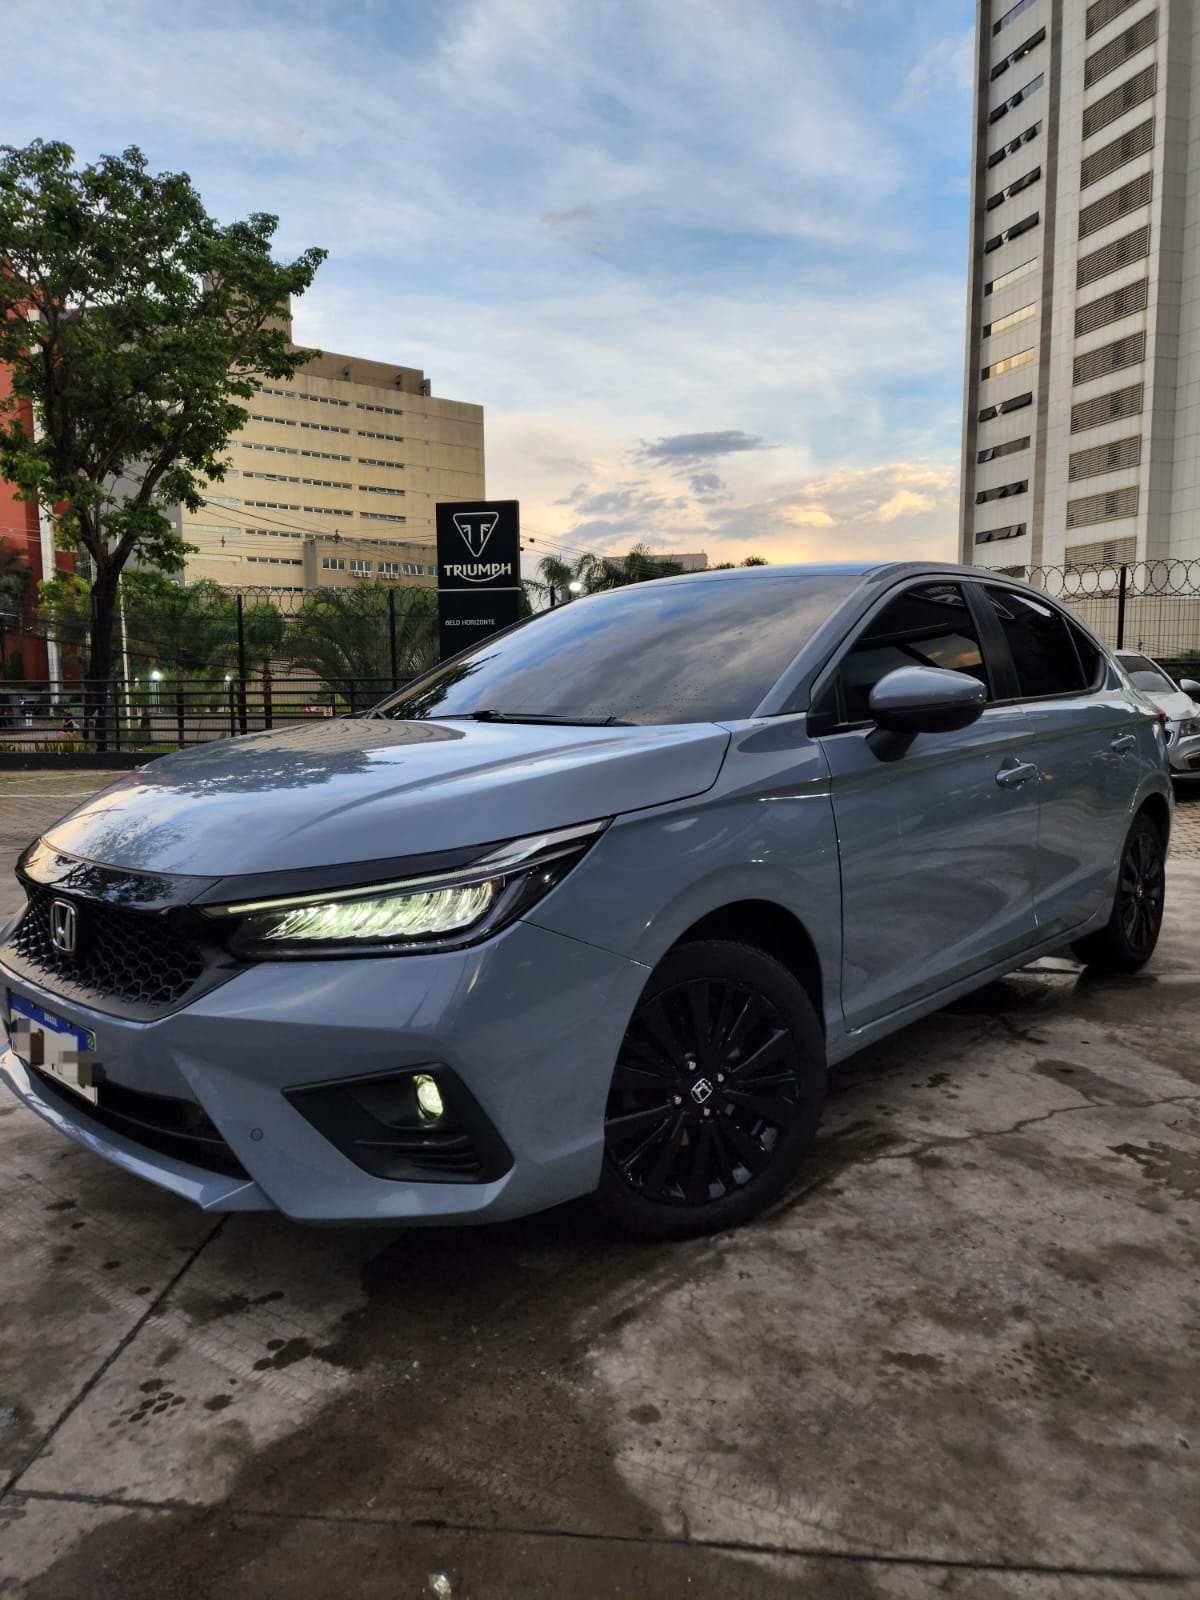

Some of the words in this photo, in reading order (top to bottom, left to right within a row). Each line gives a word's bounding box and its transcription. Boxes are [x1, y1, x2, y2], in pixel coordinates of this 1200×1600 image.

[443, 562, 512, 579] TRIUMPH
[444, 619, 461, 627] BELO
[461, 618, 496, 626] HORIZONTE
